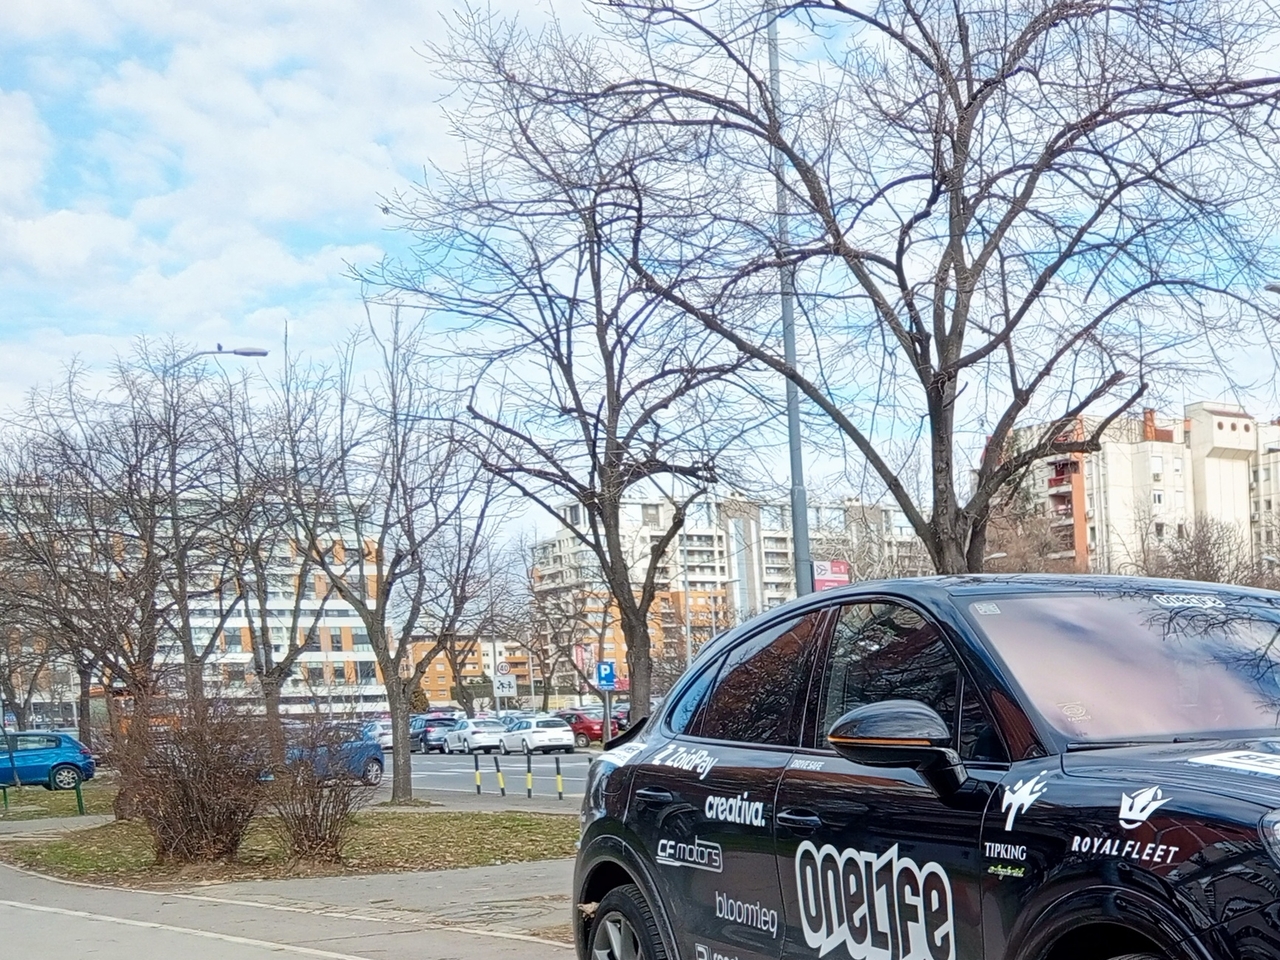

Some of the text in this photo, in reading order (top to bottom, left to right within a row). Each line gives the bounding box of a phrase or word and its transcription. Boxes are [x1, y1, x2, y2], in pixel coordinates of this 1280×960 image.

[499, 664, 508, 672] 40
[600, 664, 611, 678] P
[665, 746, 719, 780] ZoidPay
[657, 835, 720, 866] CF motors
[984, 842, 1027, 860] TIPKING
